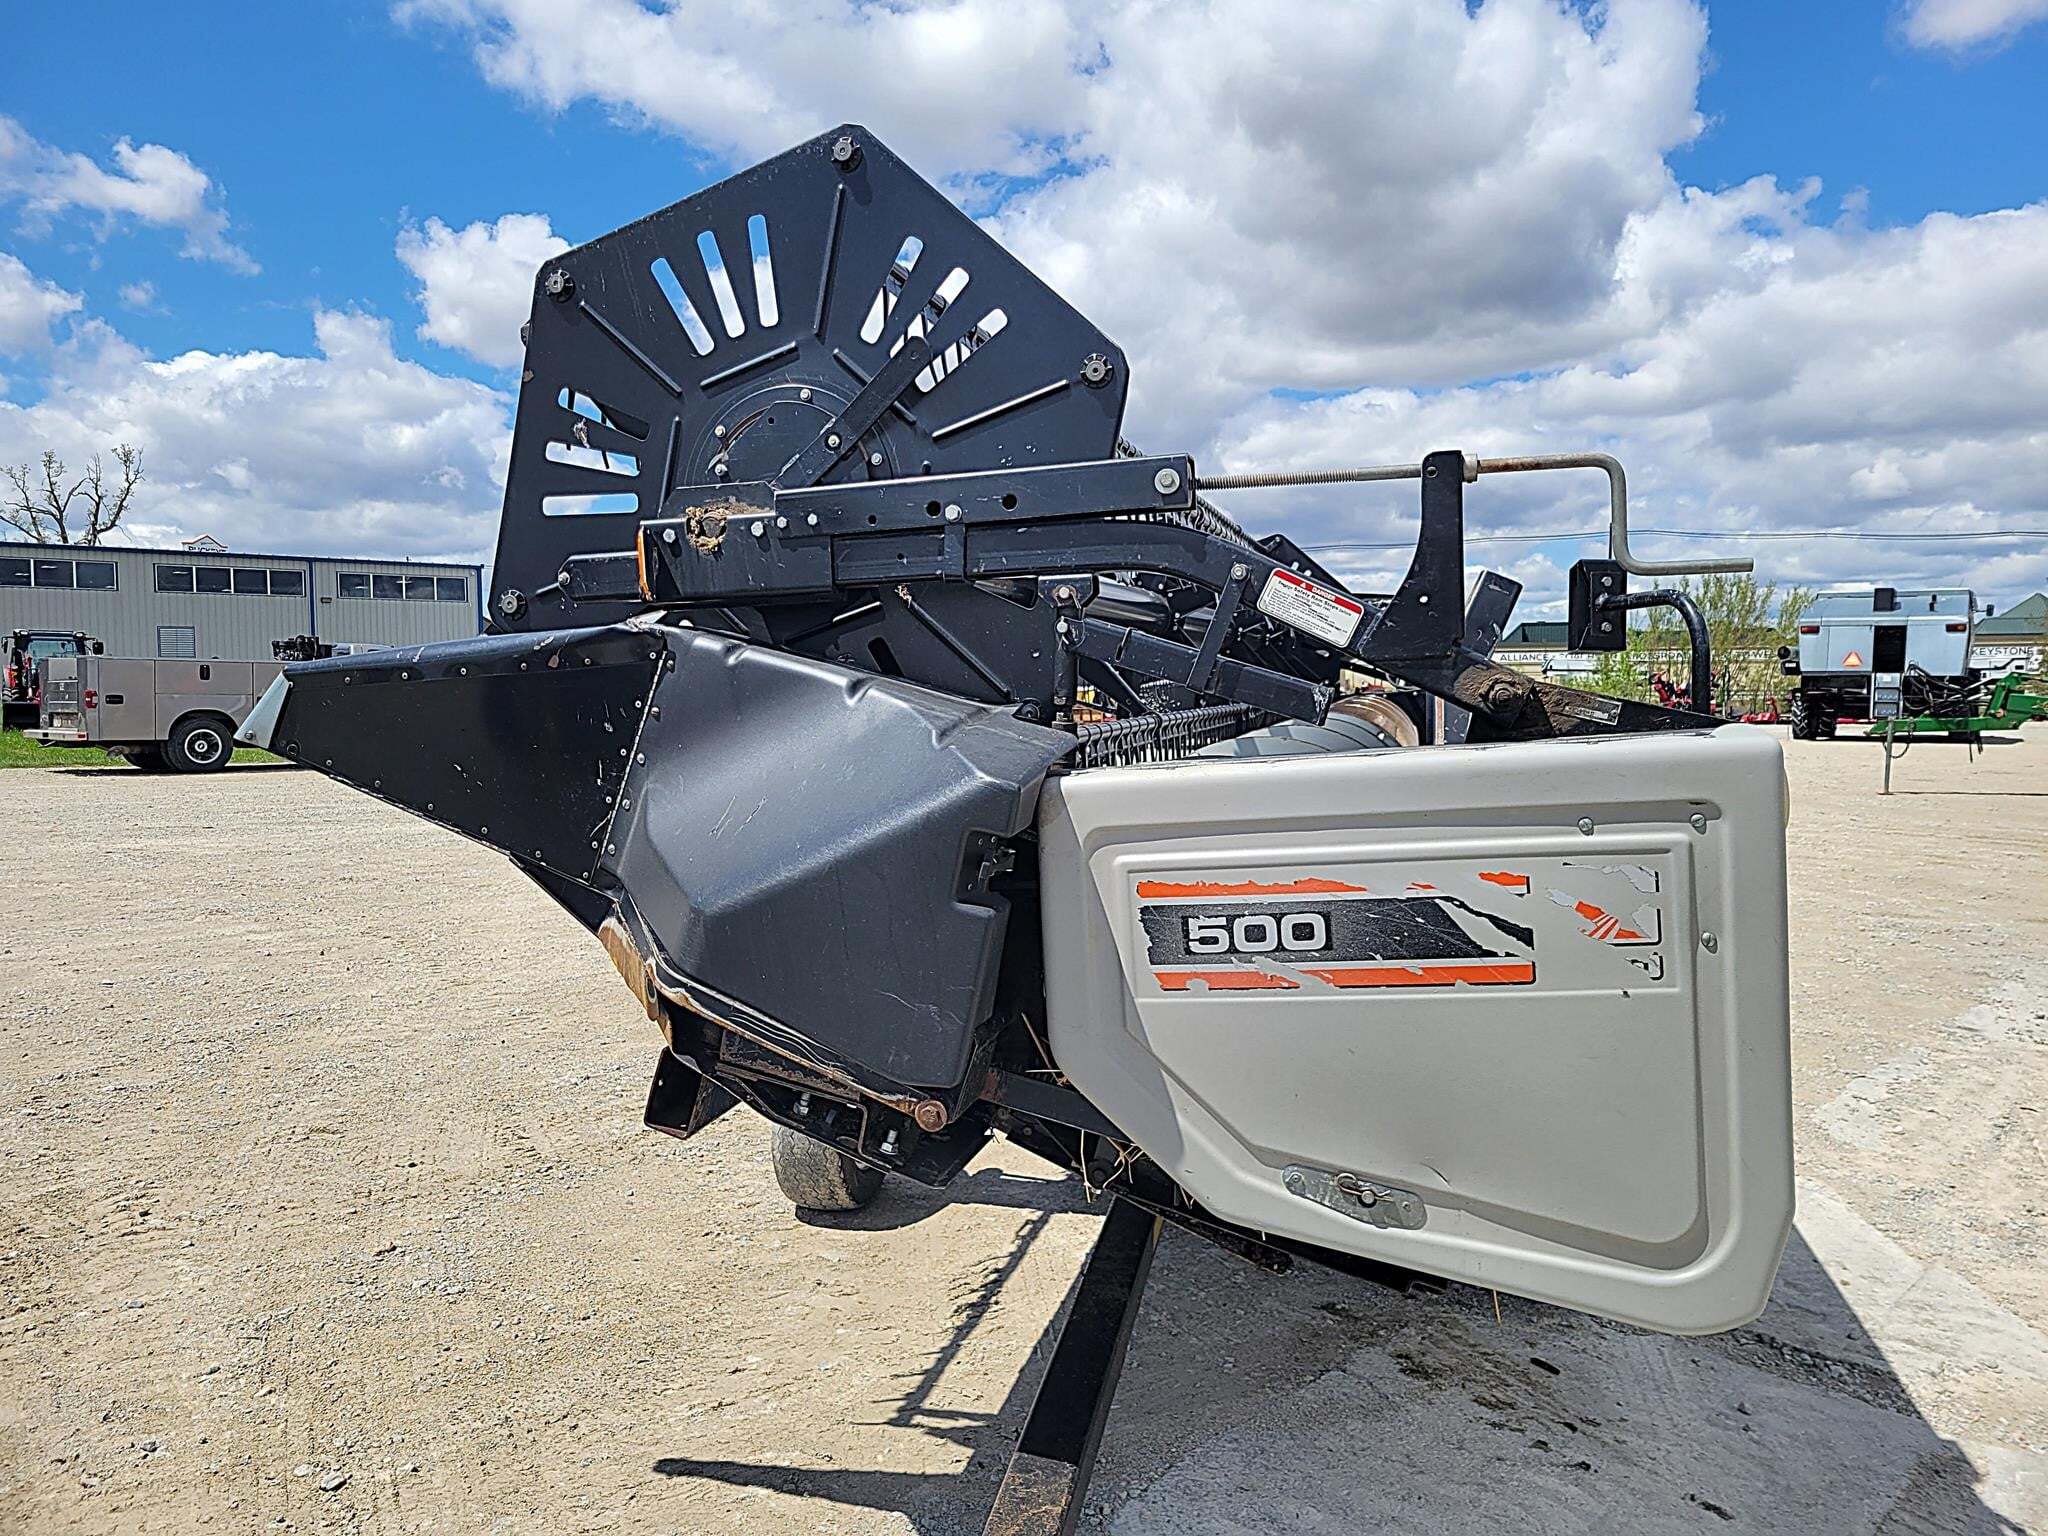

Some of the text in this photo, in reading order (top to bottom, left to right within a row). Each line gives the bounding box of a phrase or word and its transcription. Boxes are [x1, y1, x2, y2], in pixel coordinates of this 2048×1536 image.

[1293, 587, 1310, 597] Safety
[1323, 600, 1339, 611] Stops
[1311, 587, 1335, 601] DANGER
[1500, 653, 1549, 662] ALLIANCE
[1971, 647, 2034, 656] KEYSTONE
[1188, 913, 1326, 954] 500
